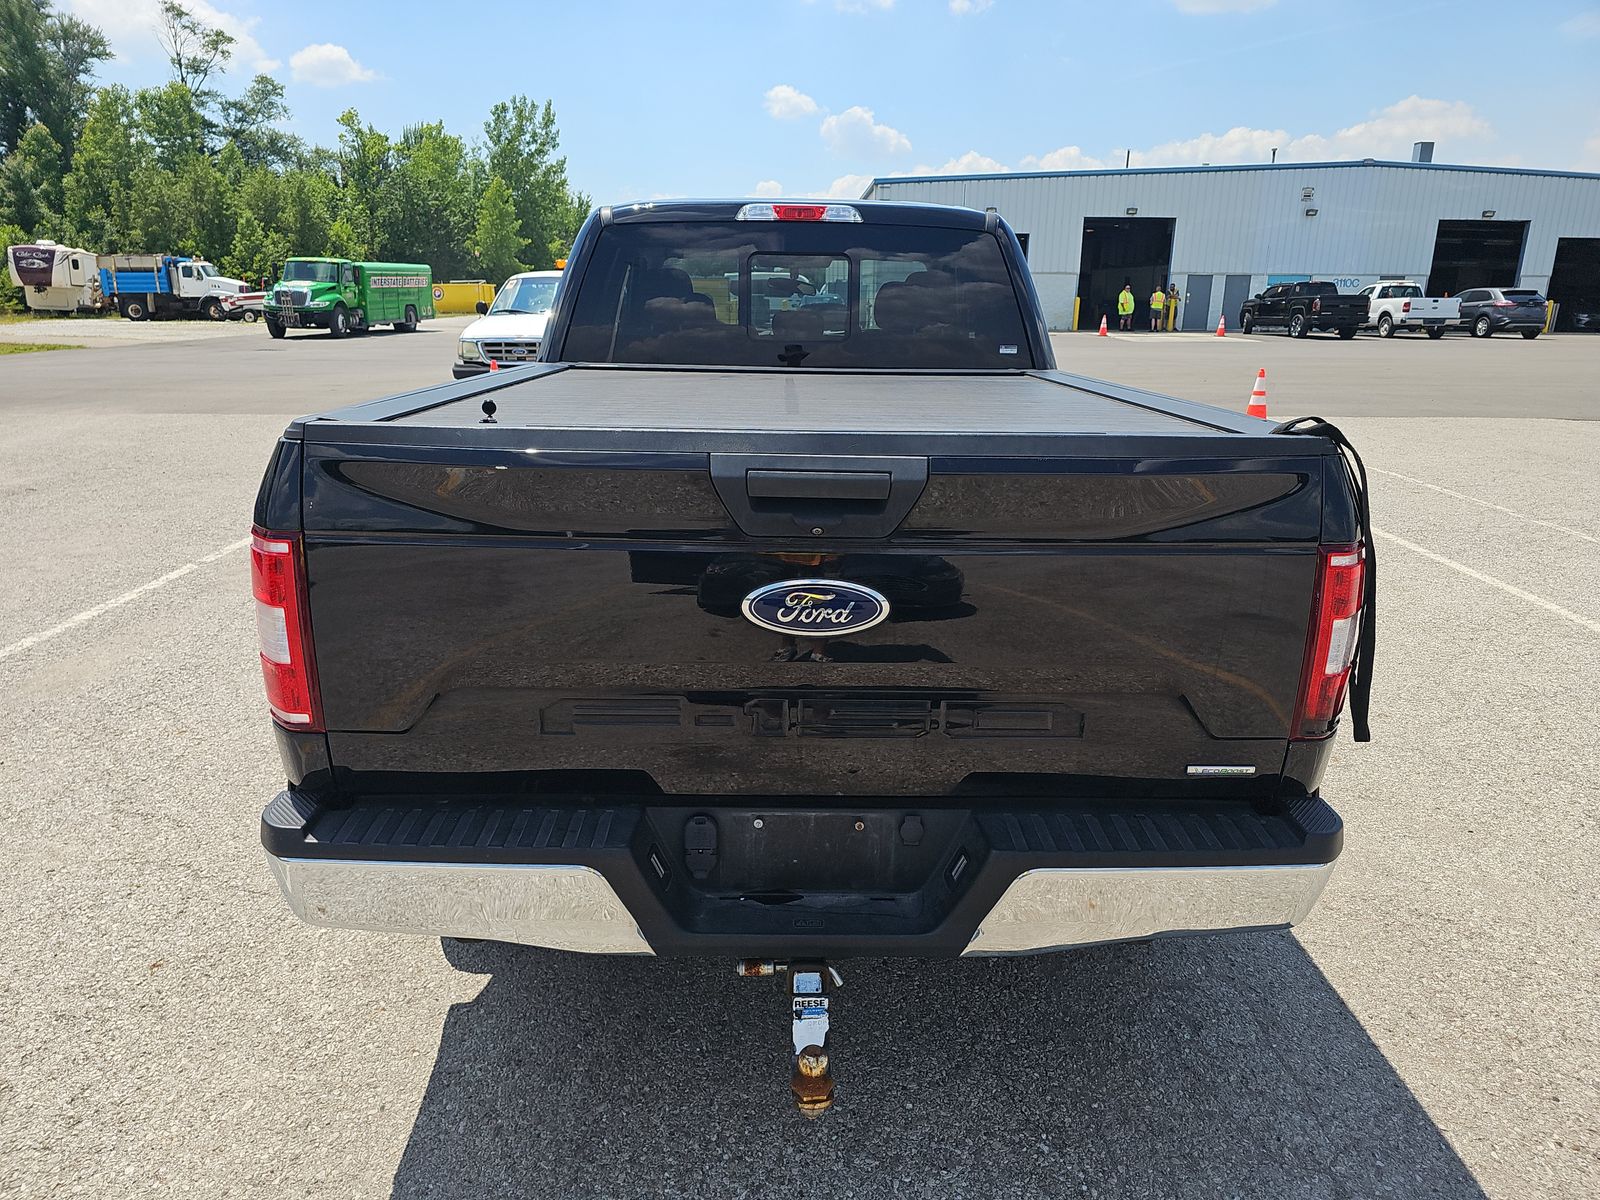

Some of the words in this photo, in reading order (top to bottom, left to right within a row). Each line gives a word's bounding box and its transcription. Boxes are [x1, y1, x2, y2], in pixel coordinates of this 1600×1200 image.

[371, 277, 402, 287] INTERSTATE
[403, 277, 428, 287] BATTERIES
[776, 592, 855, 623] Ford
[540, 697, 1084, 738] F-150
[794, 999, 826, 1008] REESE
